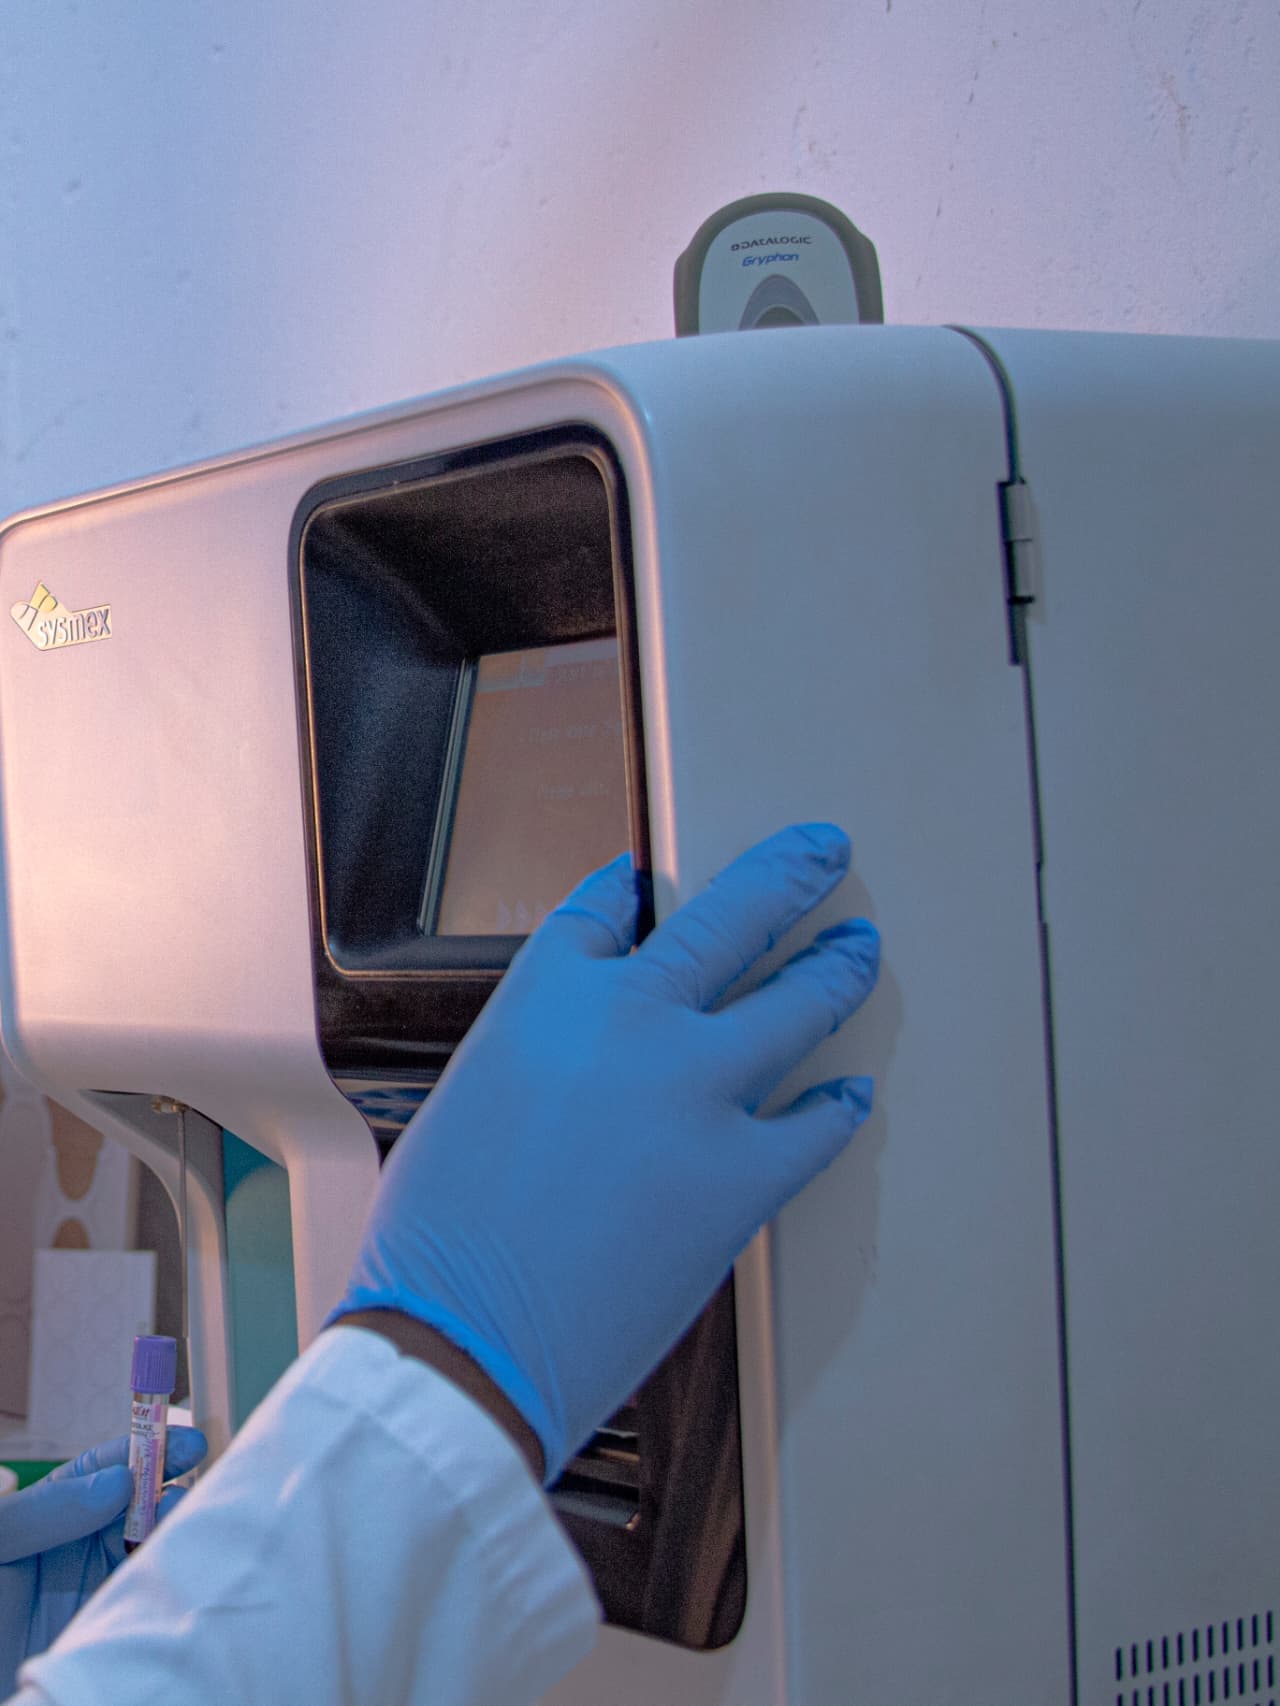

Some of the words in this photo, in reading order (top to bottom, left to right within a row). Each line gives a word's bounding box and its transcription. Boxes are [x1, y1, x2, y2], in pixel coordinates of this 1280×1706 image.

[740, 236, 812, 250] DATALOGIC
[742, 253, 800, 267] Gryphon
[37, 608, 111, 647] sysmex
